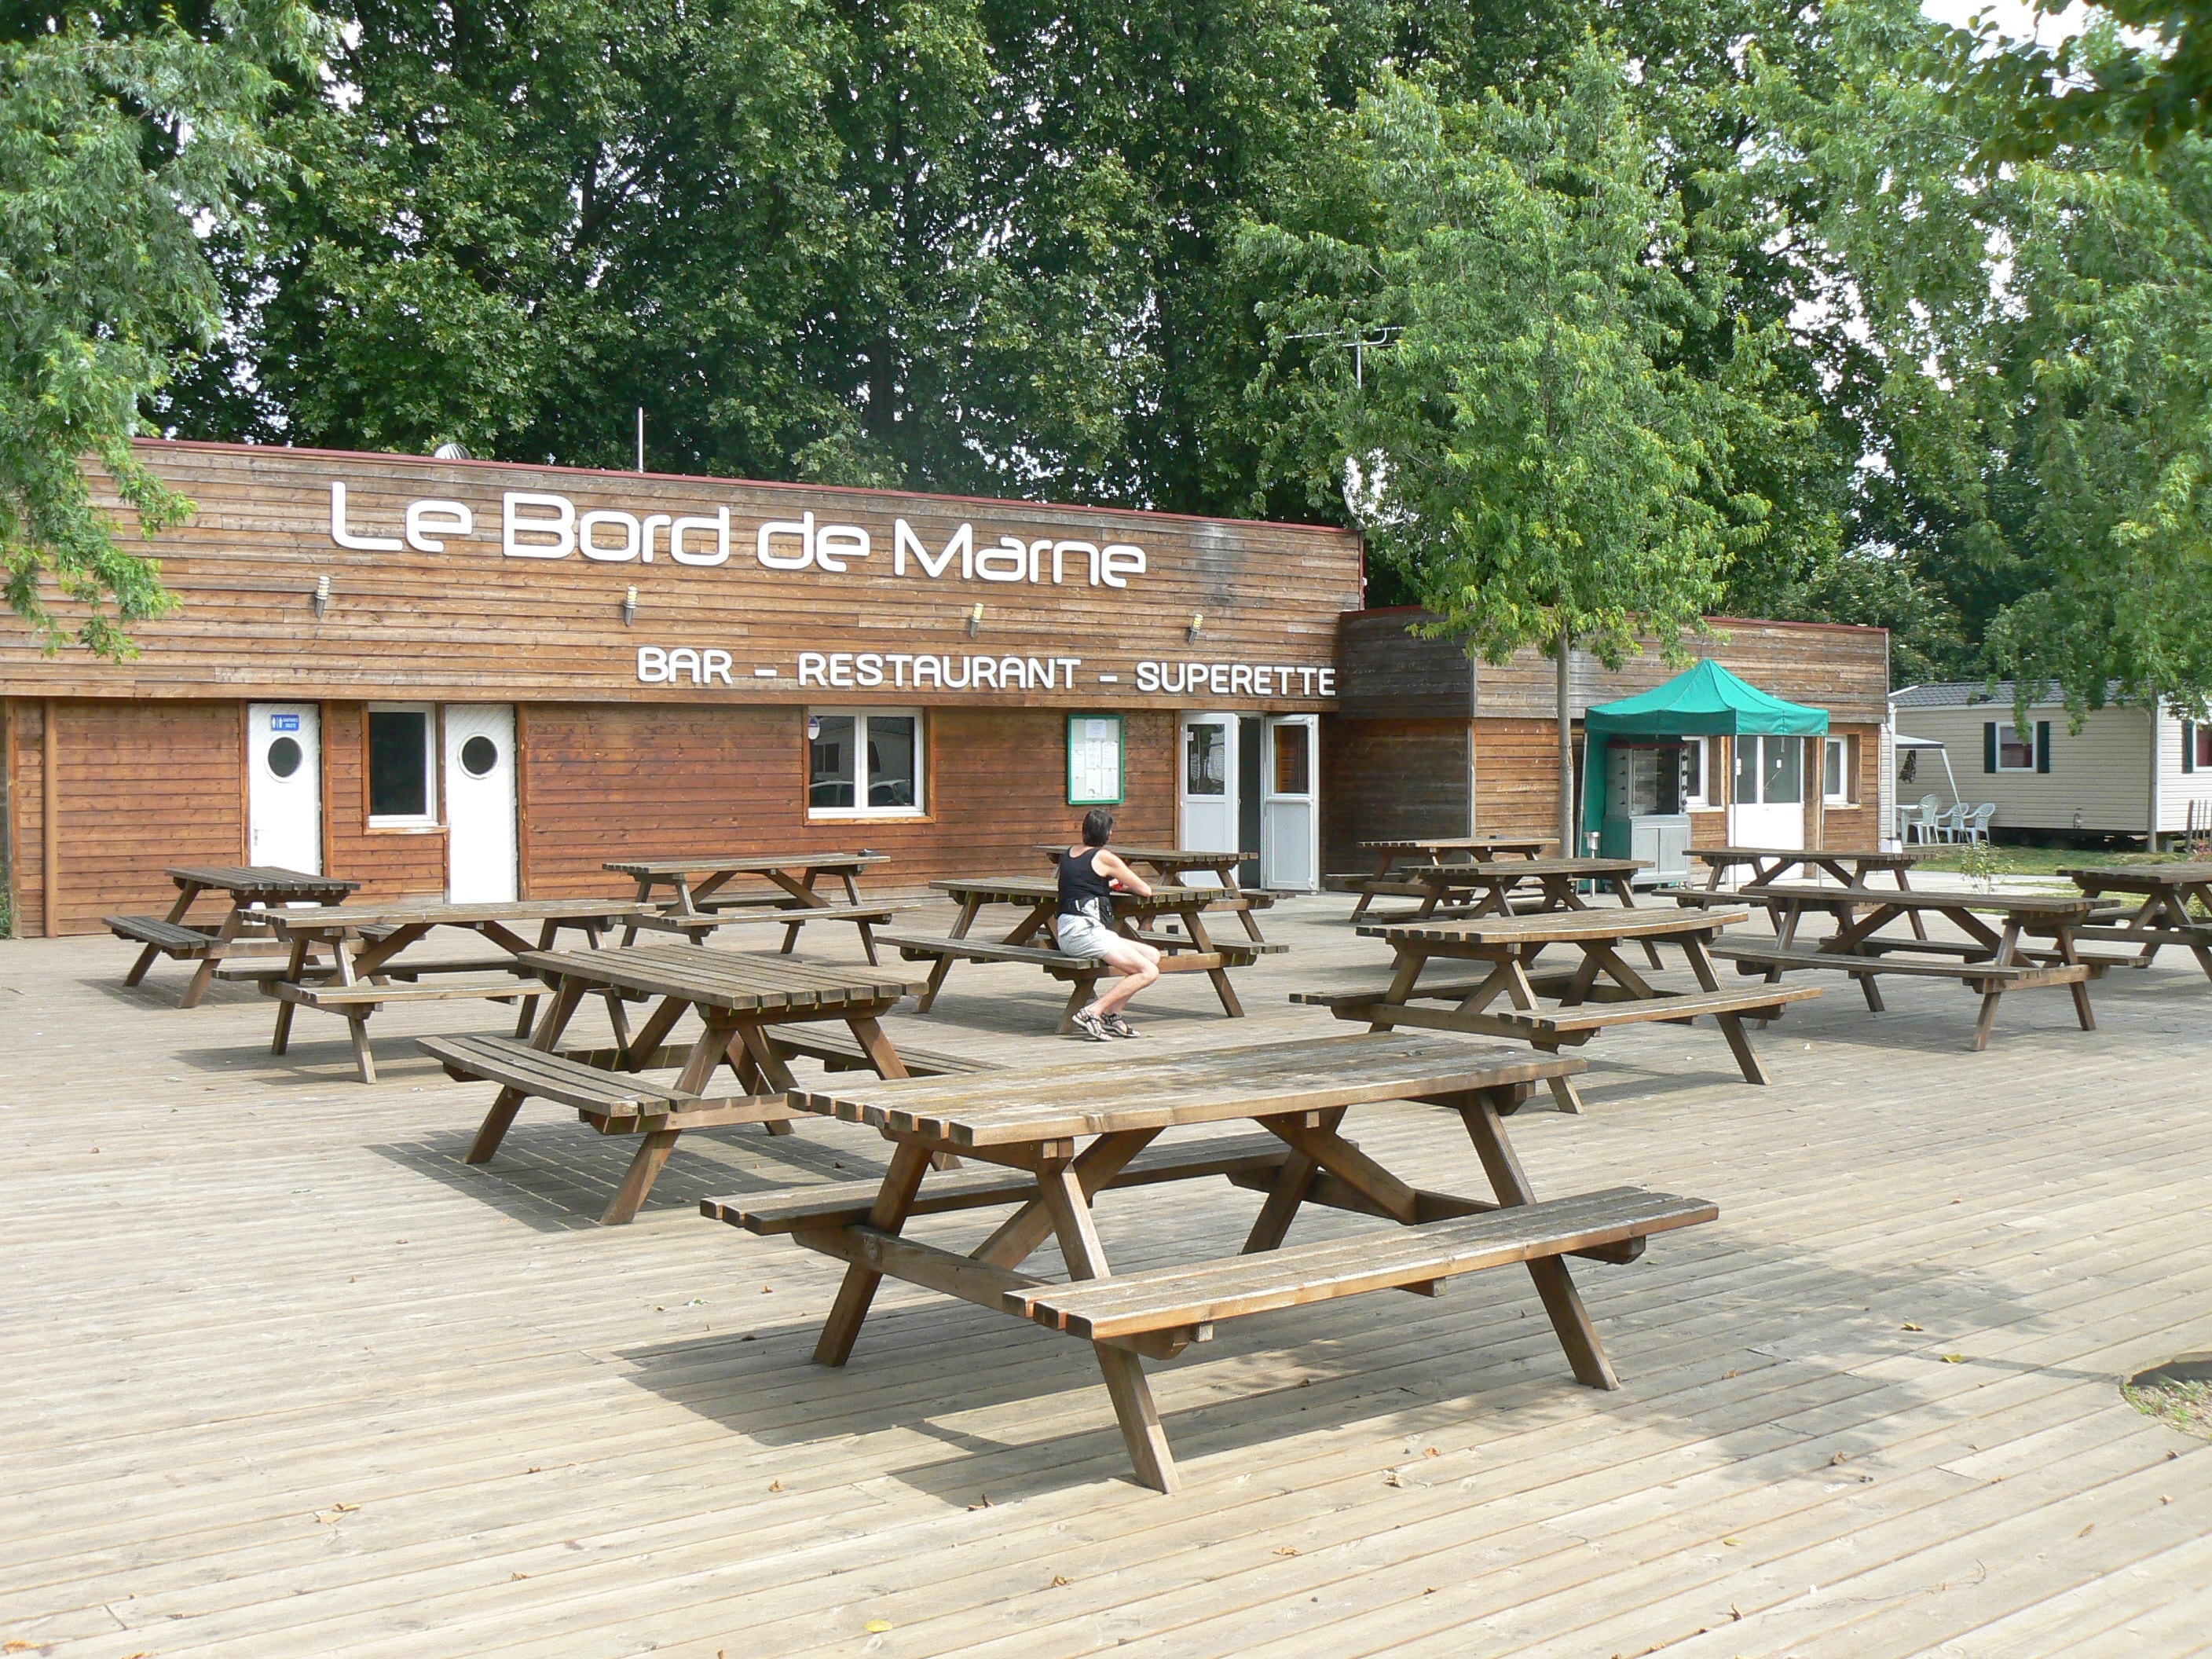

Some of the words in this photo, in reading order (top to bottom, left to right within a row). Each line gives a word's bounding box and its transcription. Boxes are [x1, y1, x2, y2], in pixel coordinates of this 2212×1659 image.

[331, 480, 473, 553] Le
[502, 491, 731, 566] Bord
[756, 510, 871, 573] de
[893, 518, 1147, 588] Marne
[637, 646, 734, 685] BAR
[797, 651, 1082, 690] RESTAURANT
[1136, 661, 1337, 696] SUPERETTE
